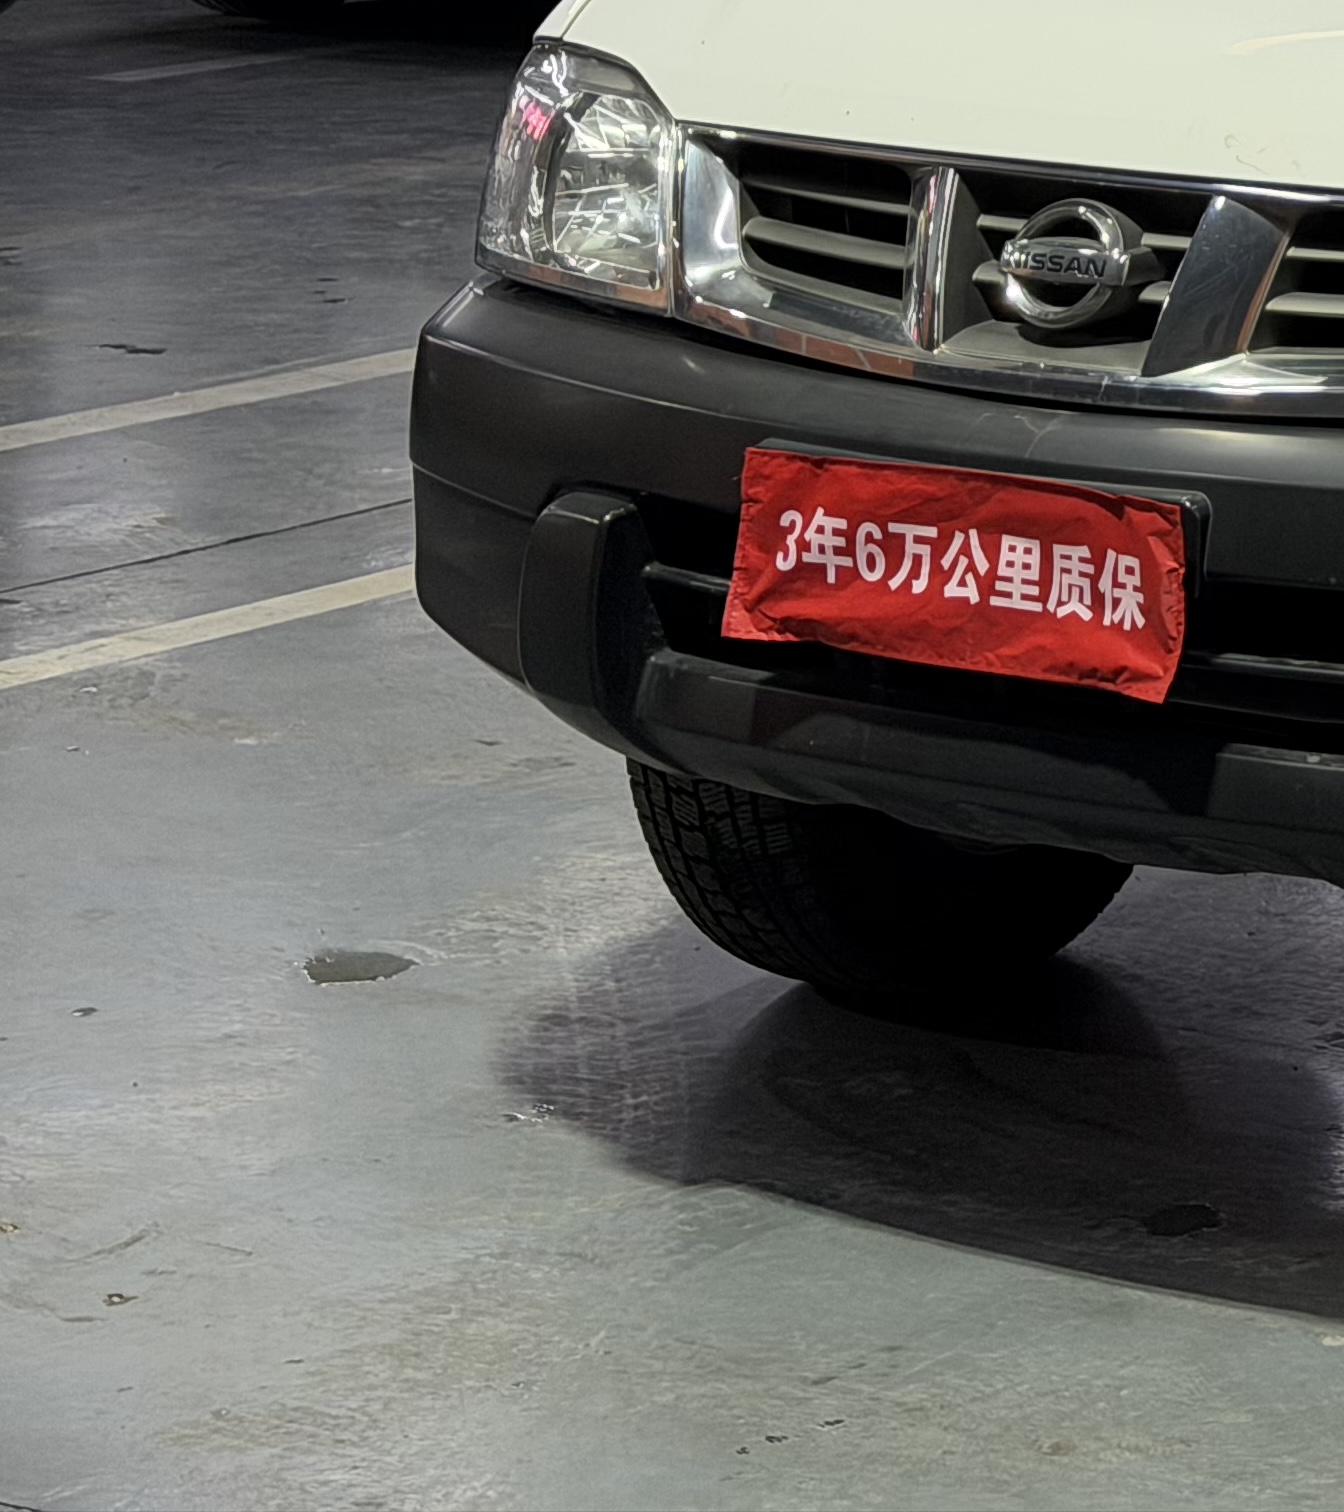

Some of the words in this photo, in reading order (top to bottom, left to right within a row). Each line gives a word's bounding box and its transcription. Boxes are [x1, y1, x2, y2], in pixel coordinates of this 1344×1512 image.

[774, 505, 1147, 633] 3年6万公里质保
